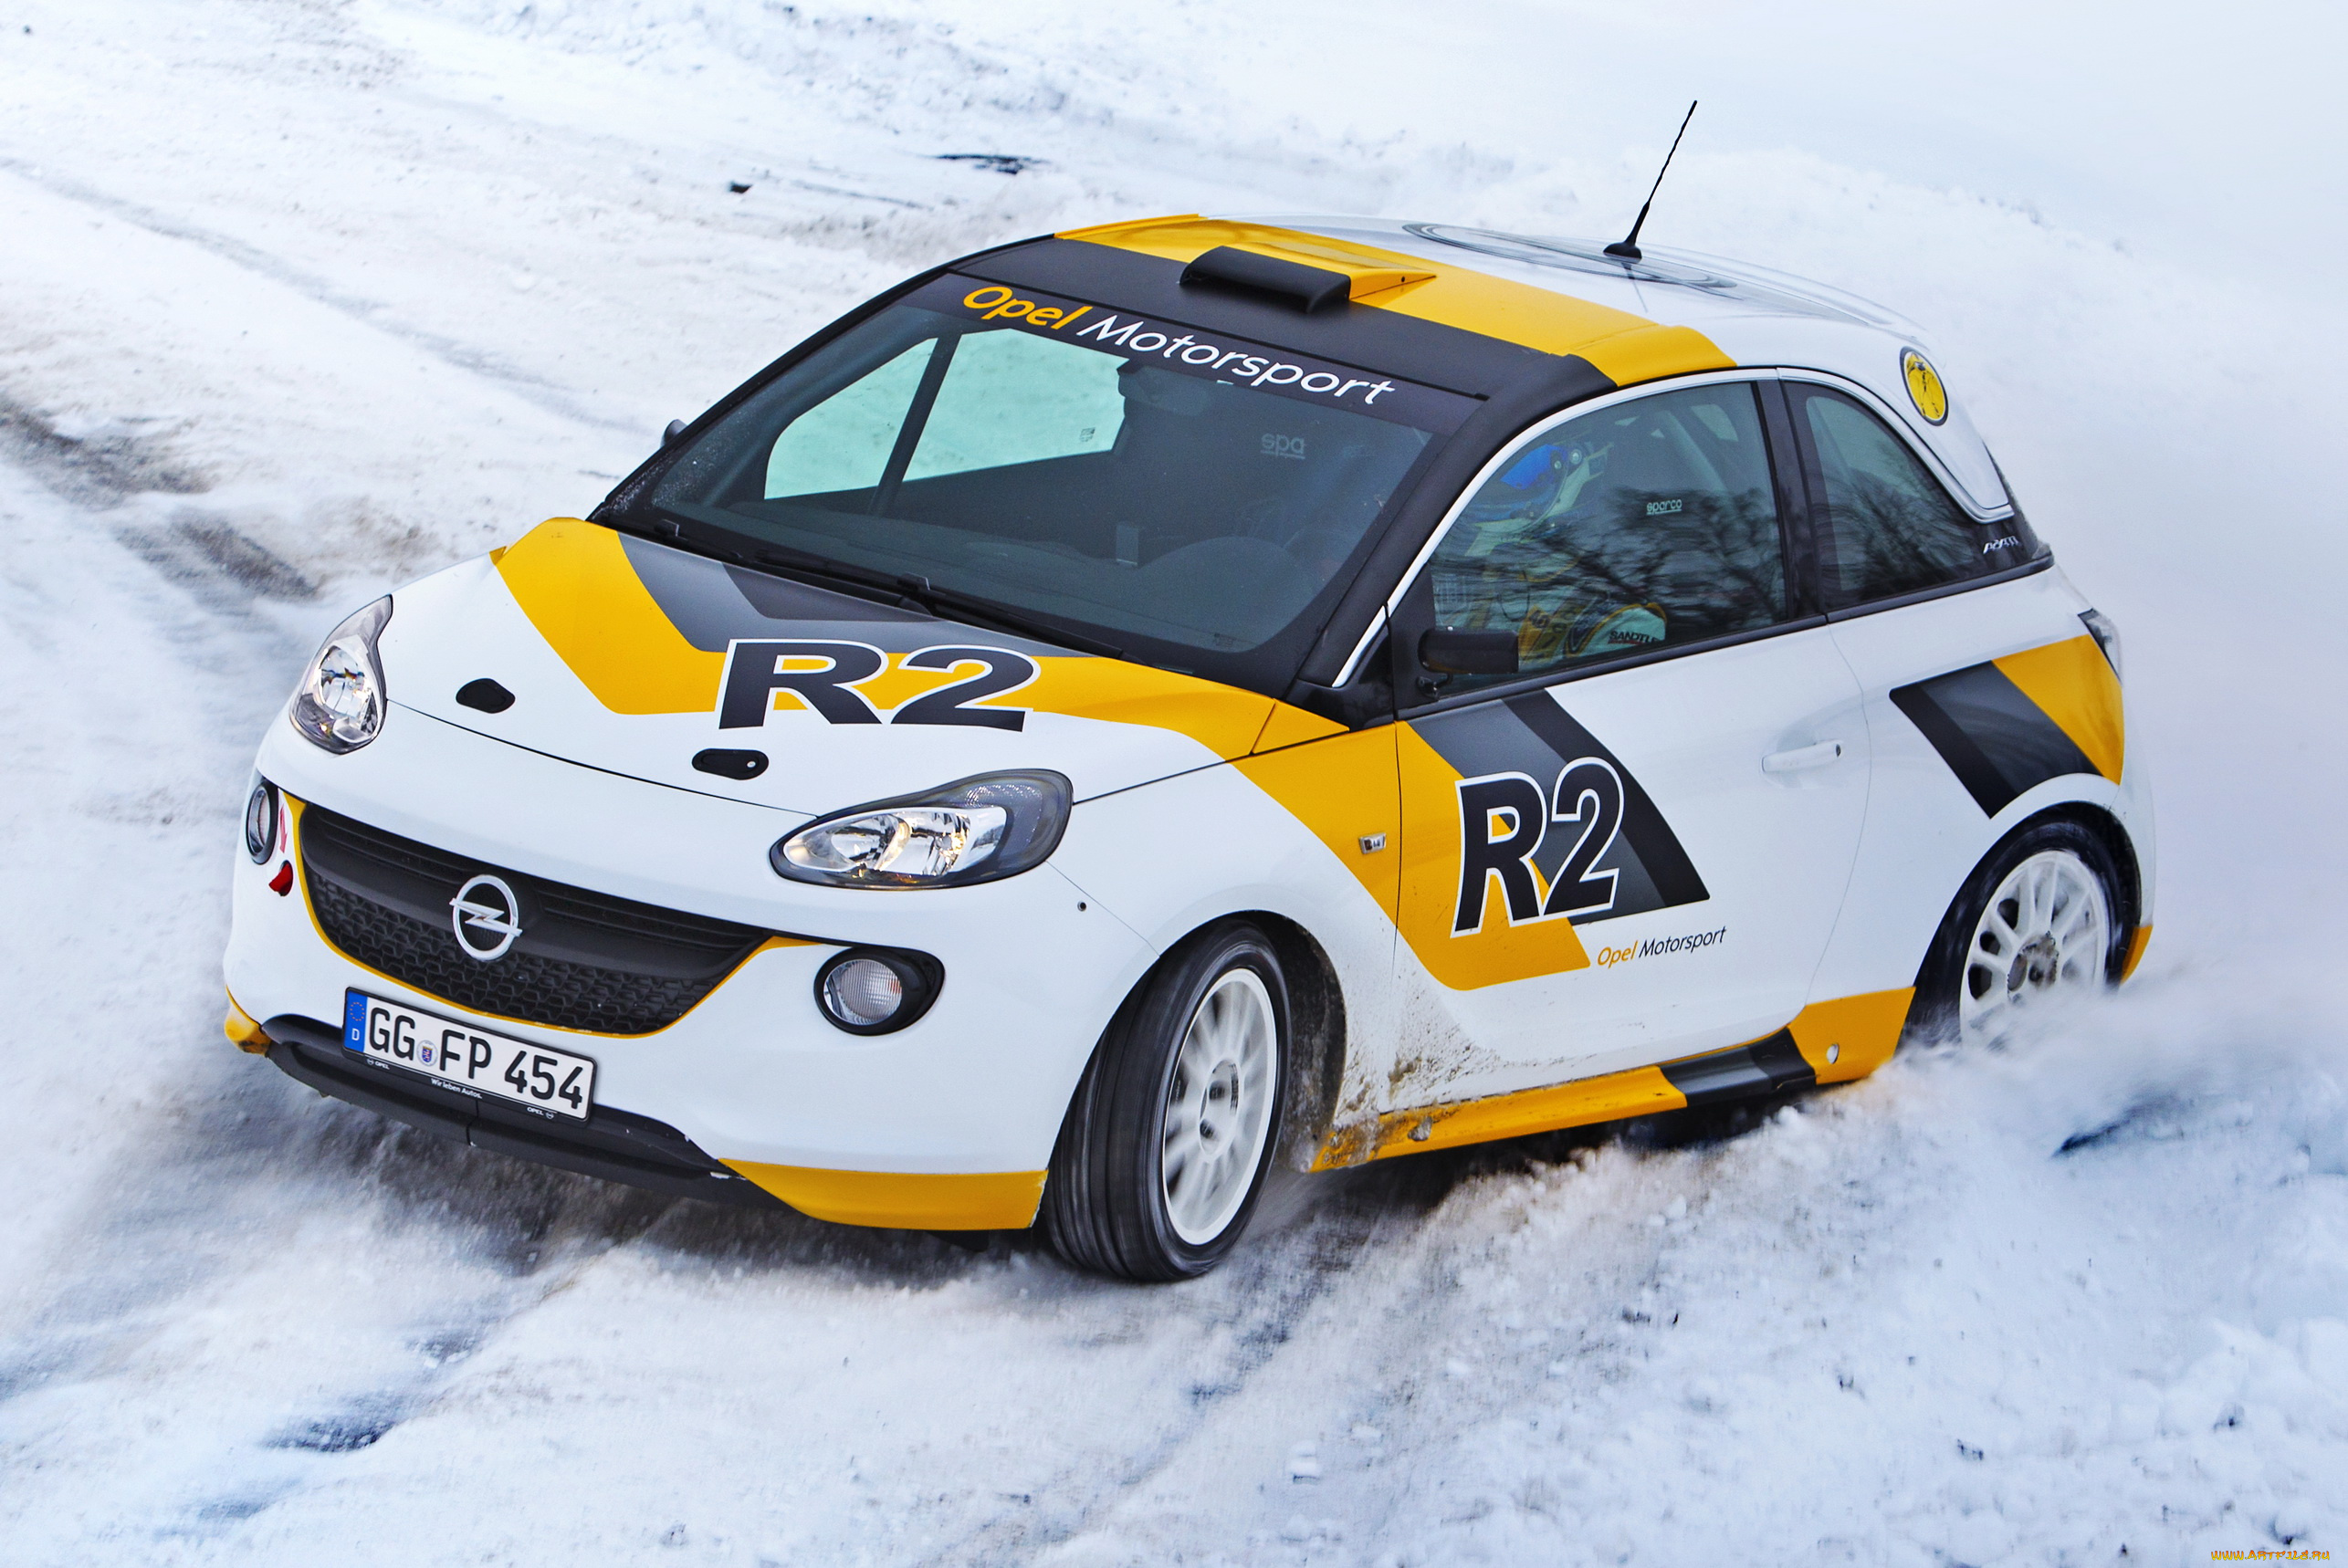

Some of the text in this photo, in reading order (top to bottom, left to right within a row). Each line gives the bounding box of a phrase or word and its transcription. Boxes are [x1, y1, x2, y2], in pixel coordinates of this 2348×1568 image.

[962, 286, 1396, 404] Opel Motorsport
[1646, 498, 1682, 516] sparco
[714, 638, 1042, 733] R2
[1450, 756, 1625, 938] R2
[1597, 925, 1726, 969] Opel Motorsport
[351, 1028, 361, 1041] D
[369, 1007, 584, 1111] GG FP 454
[431, 1078, 442, 1087] Wir
[442, 1080, 461, 1092] leben
